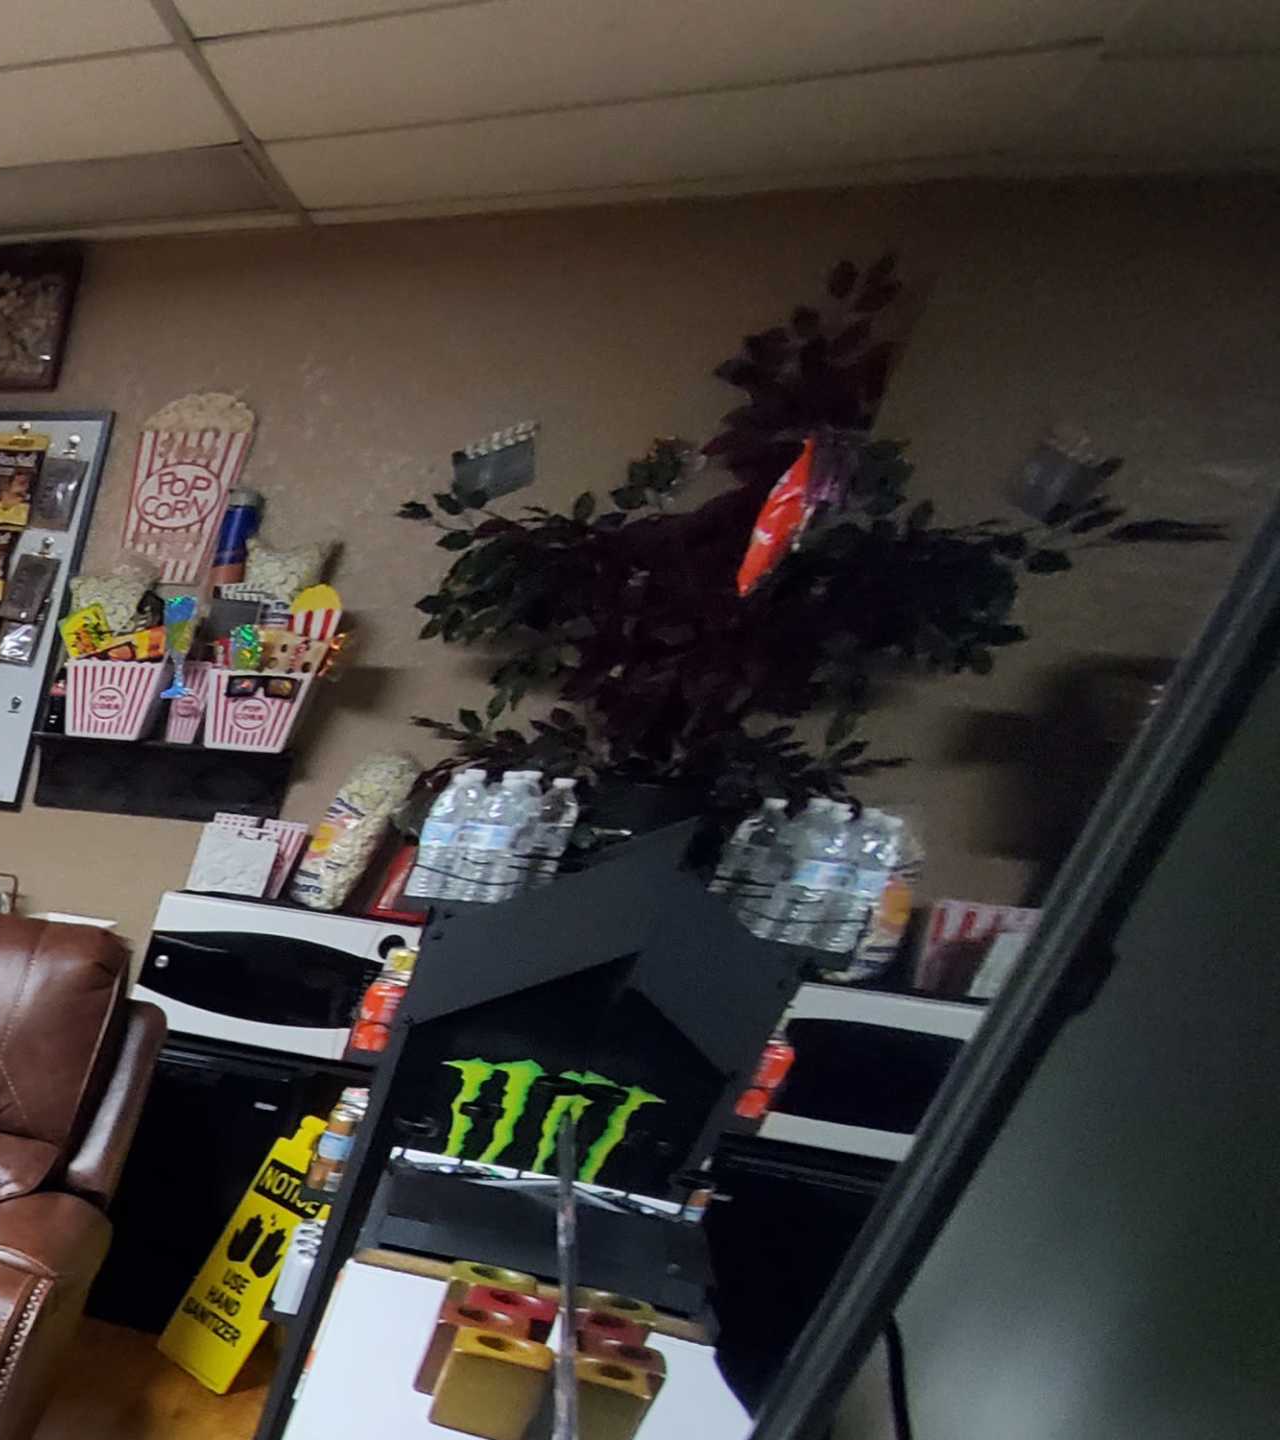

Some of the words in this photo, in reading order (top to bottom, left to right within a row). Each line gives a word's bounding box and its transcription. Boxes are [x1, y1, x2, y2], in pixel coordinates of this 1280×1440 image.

[158, 471, 213, 498] POP
[141, 496, 209, 521] CORN
[222, 1268, 250, 1295] USE
[182, 1296, 241, 1347] SANITIZER
